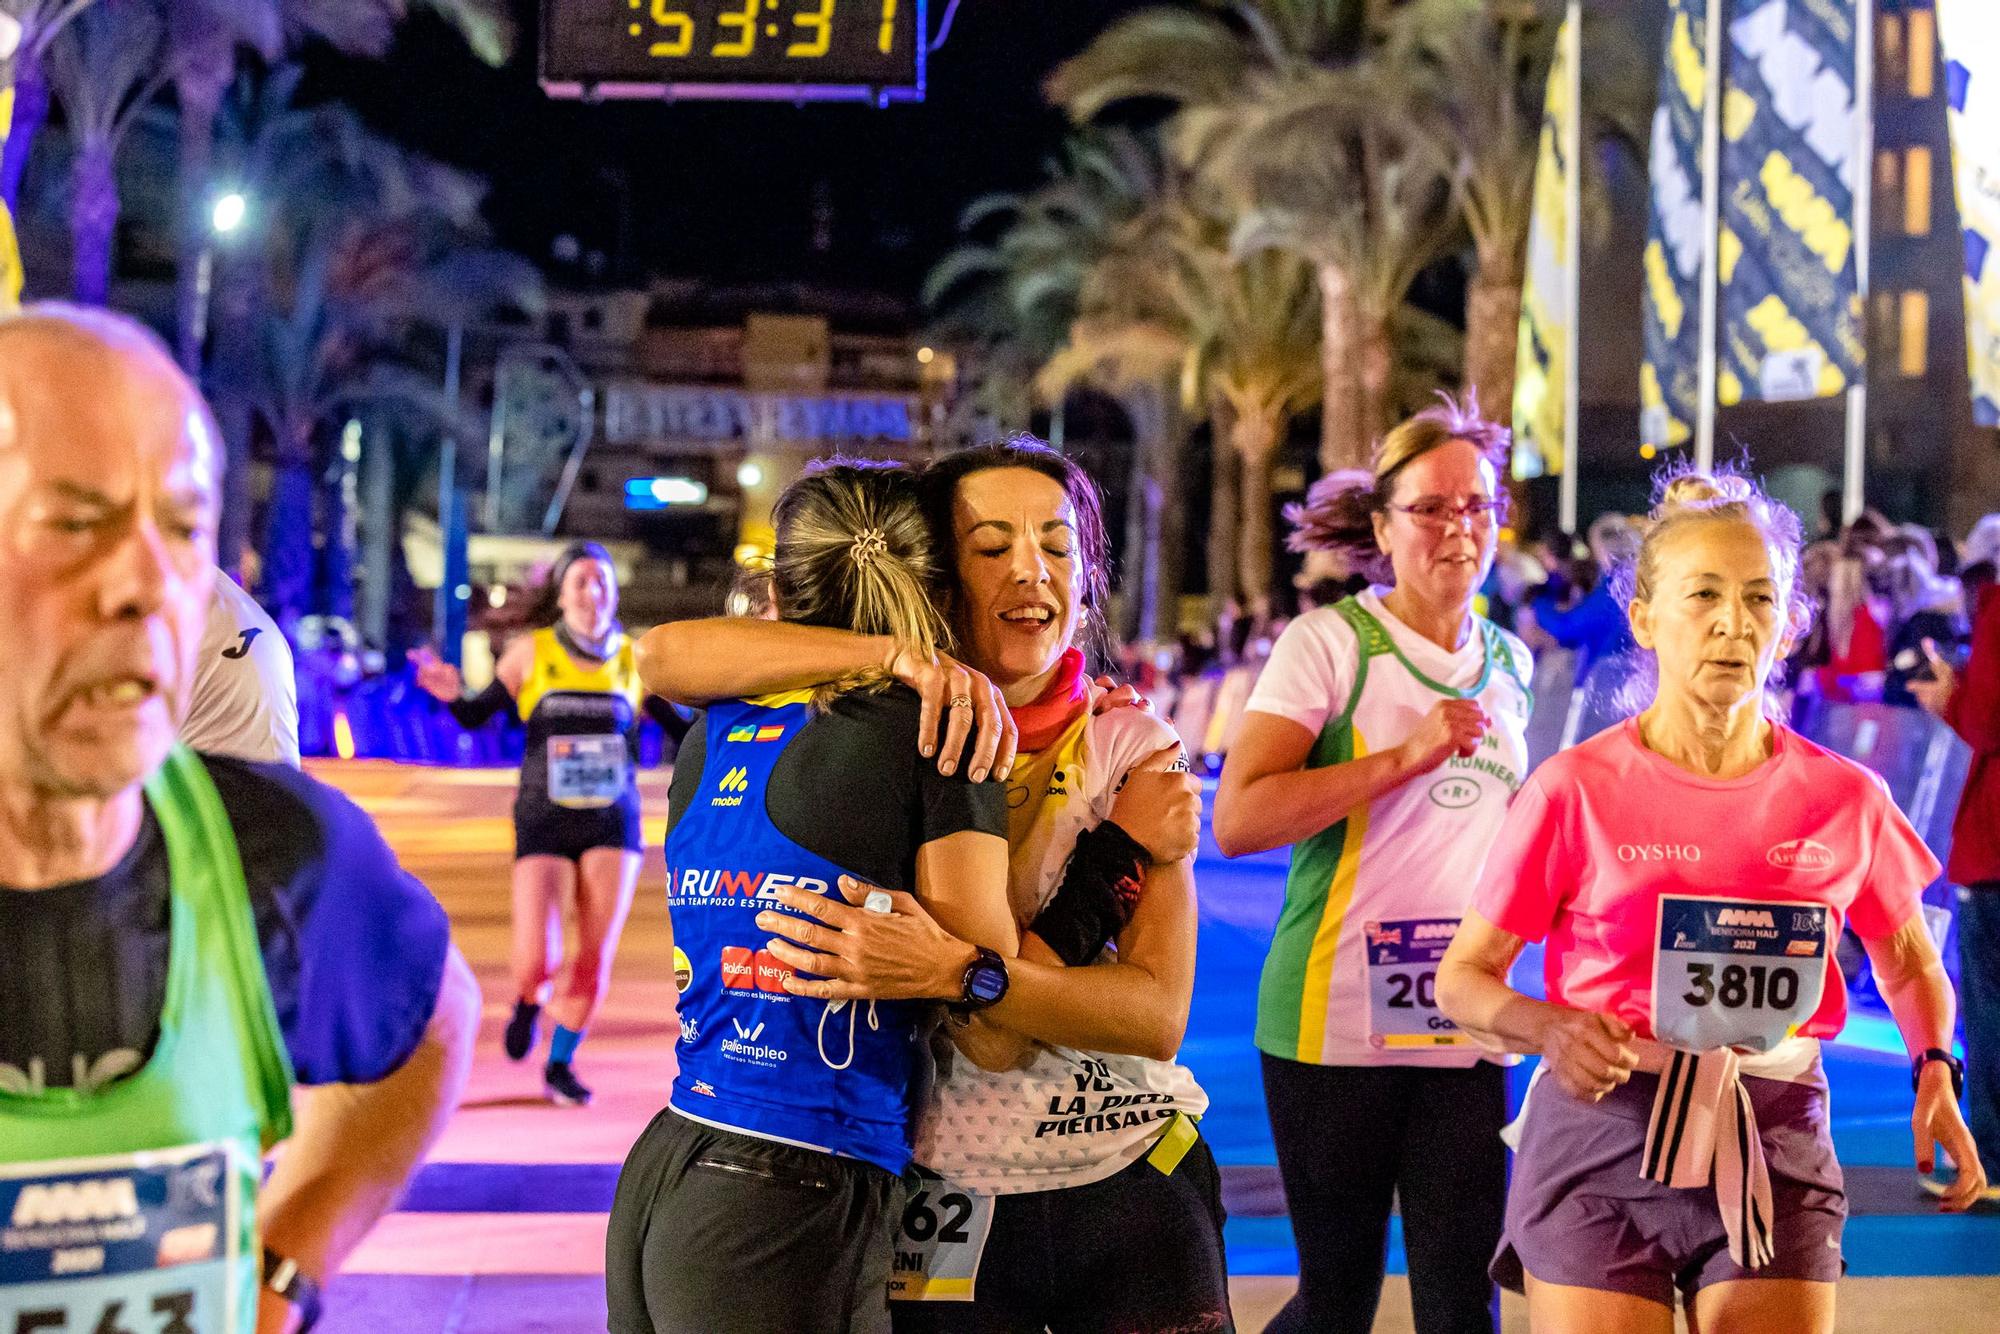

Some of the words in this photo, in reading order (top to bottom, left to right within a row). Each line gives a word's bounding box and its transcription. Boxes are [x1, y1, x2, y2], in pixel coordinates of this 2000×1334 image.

[711, 796, 743, 806] mobel
[1617, 844, 1701, 862] OYSHO
[688, 897, 707, 906] TEAM
[710, 898, 735, 907] POZO
[1756, 930, 1779, 939] HALF
[1733, 940, 1757, 950] 2021
[1682, 963, 1799, 1011] 3810
[1048, 1095, 1087, 1116] LA
[902, 1190, 973, 1244] 62
